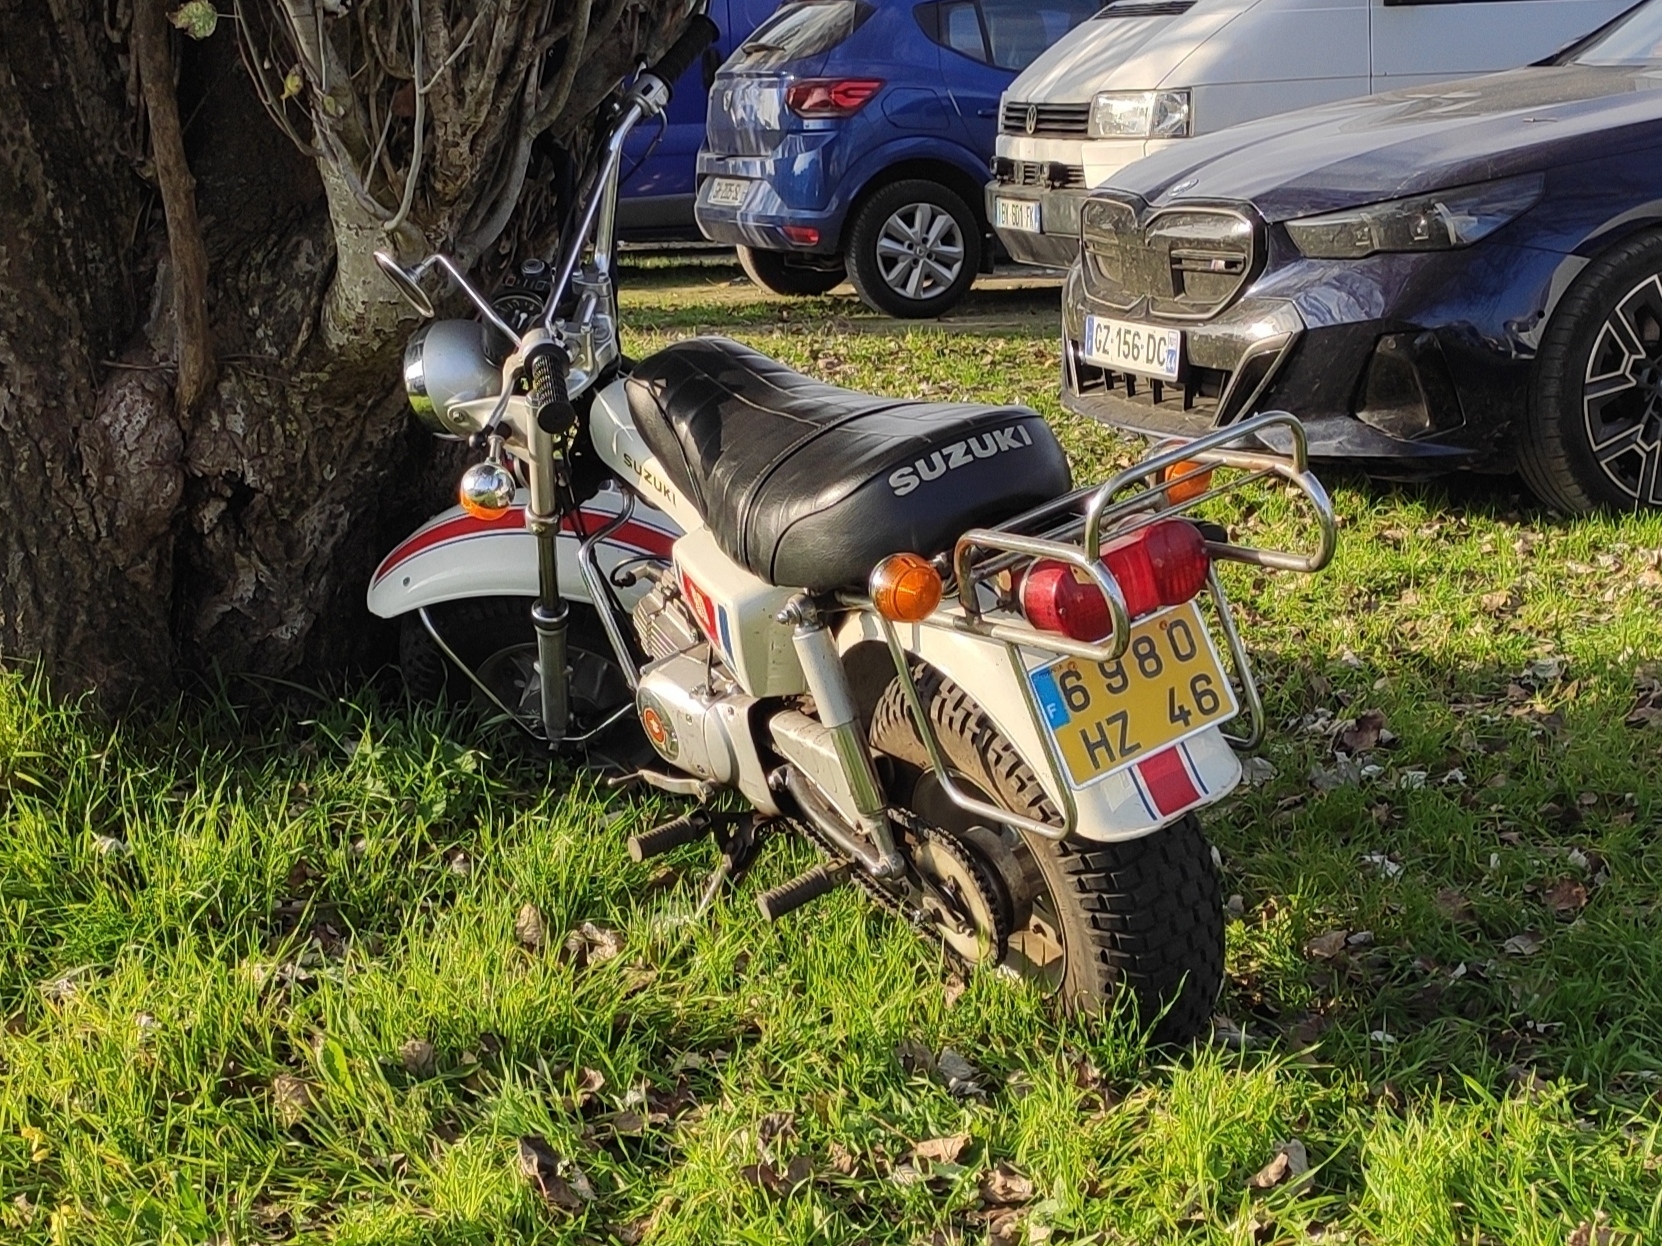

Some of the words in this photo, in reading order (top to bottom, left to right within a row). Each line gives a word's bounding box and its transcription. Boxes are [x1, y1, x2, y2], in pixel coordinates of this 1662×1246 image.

[623, 452, 677, 509] SUZUKI
[888, 424, 1033, 497] SUZUKI
[1058, 618, 1197, 713] 6980
[1079, 709, 1142, 770] HZ
[1167, 672, 1221, 728] 46
